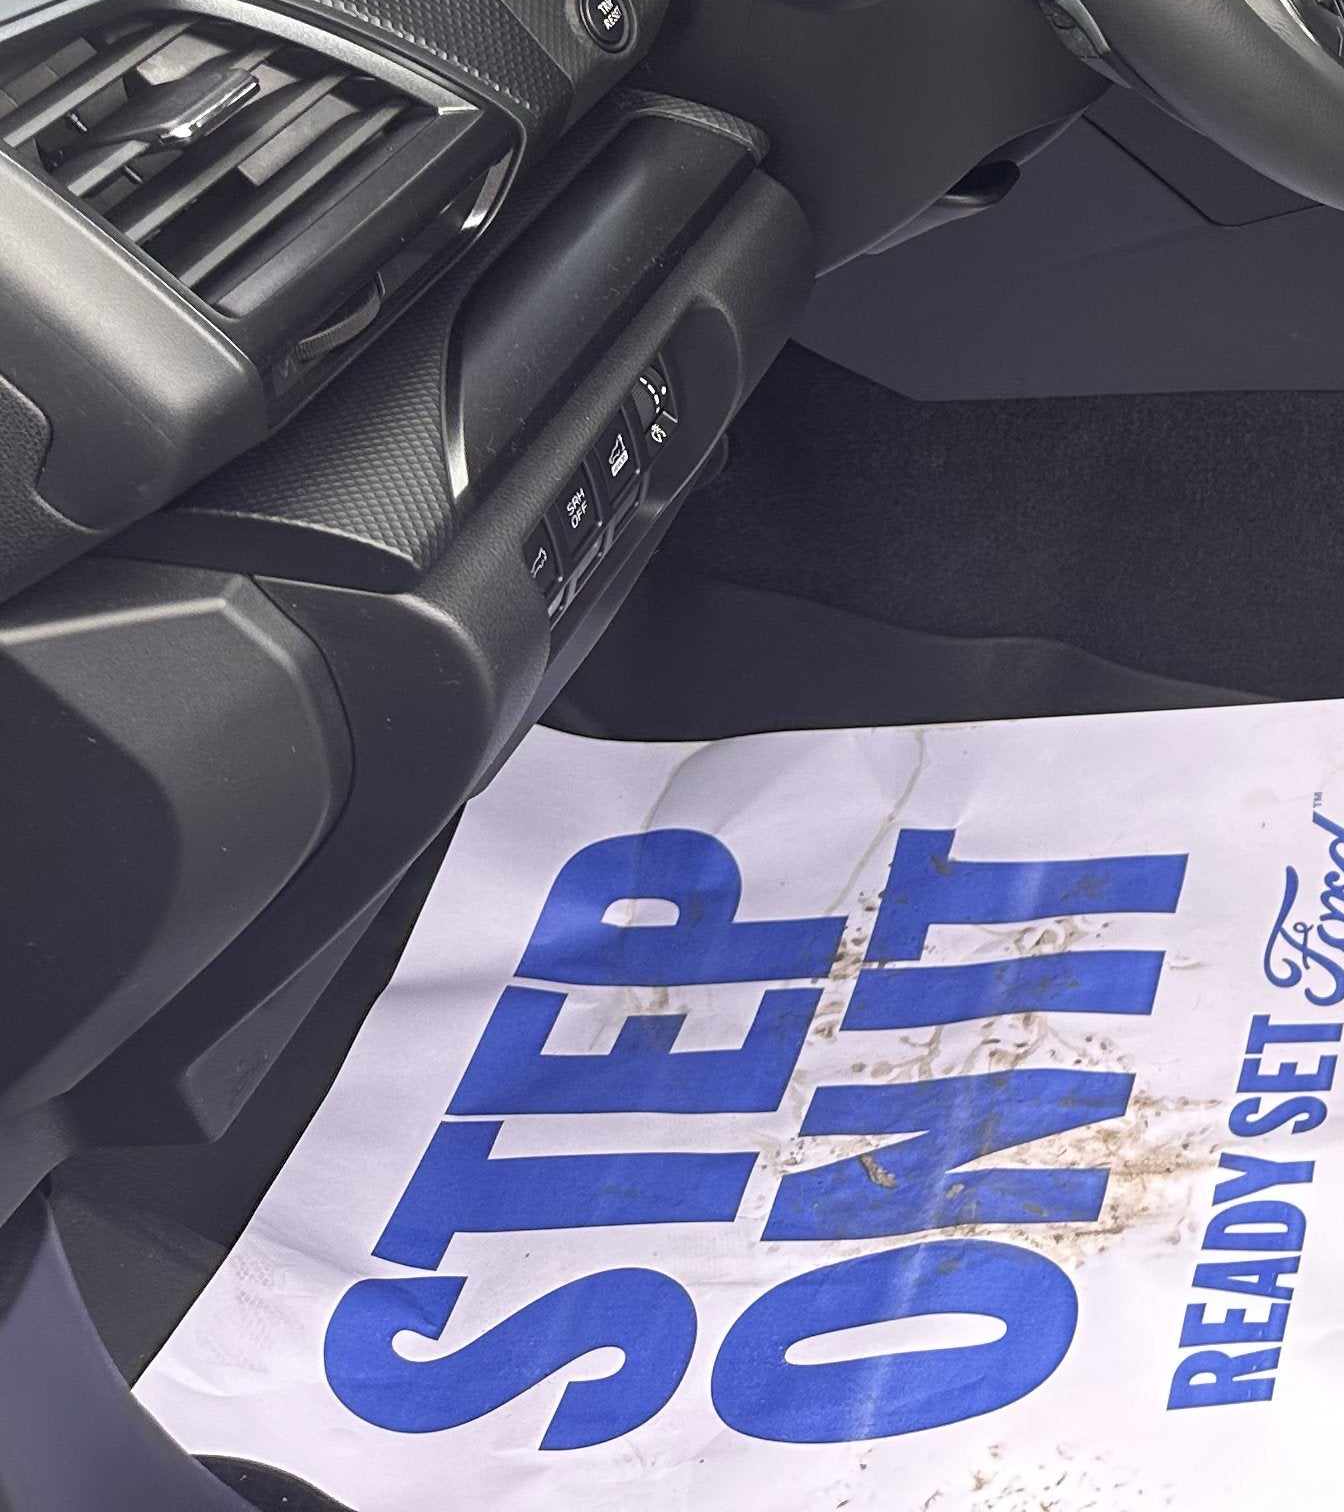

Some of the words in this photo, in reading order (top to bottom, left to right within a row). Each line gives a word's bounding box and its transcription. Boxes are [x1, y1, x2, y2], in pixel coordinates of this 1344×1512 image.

[603, 5, 622, 30] RESET
[566, 487, 585, 517] SRH
[571, 500, 588, 529] OFF
[843, 828, 1189, 1032] IT
[324, 828, 845, 1450] STEP
[1229, 1014, 1342, 1139] SET
[711, 1070, 1137, 1444] ON
[1166, 1157, 1314, 1411] READY
